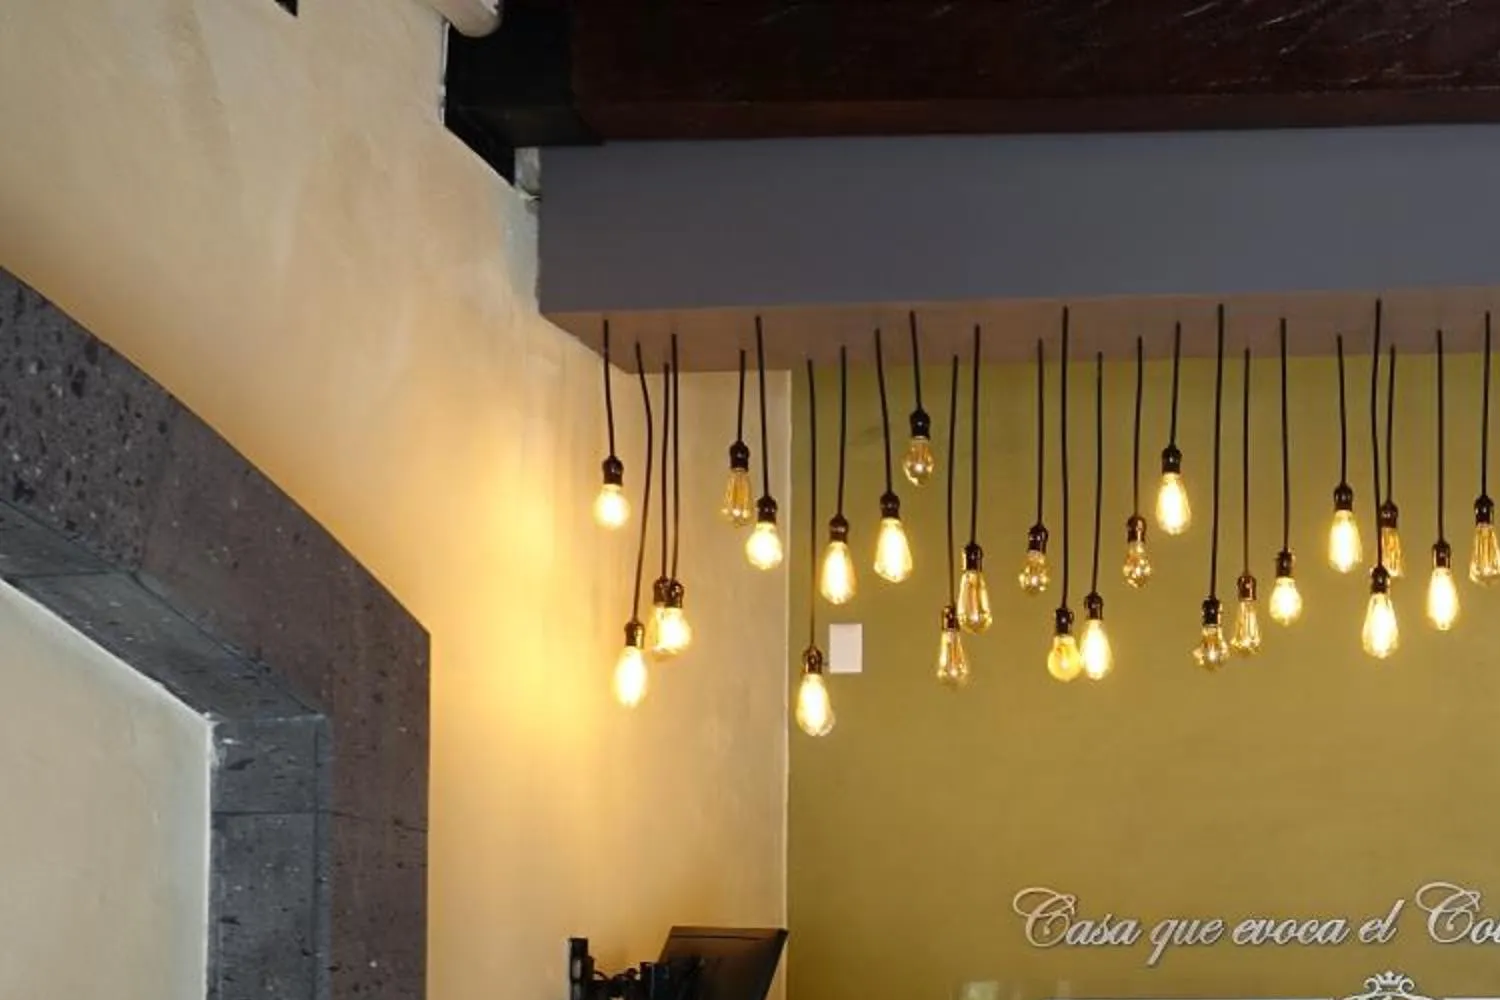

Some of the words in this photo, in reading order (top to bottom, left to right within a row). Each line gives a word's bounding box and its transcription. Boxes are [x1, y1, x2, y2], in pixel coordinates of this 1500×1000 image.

[1013, 887, 1141, 947] Casa
[1147, 918, 1224, 967] que
[1232, 918, 1350, 945] evoca
[1358, 899, 1405, 944] el
